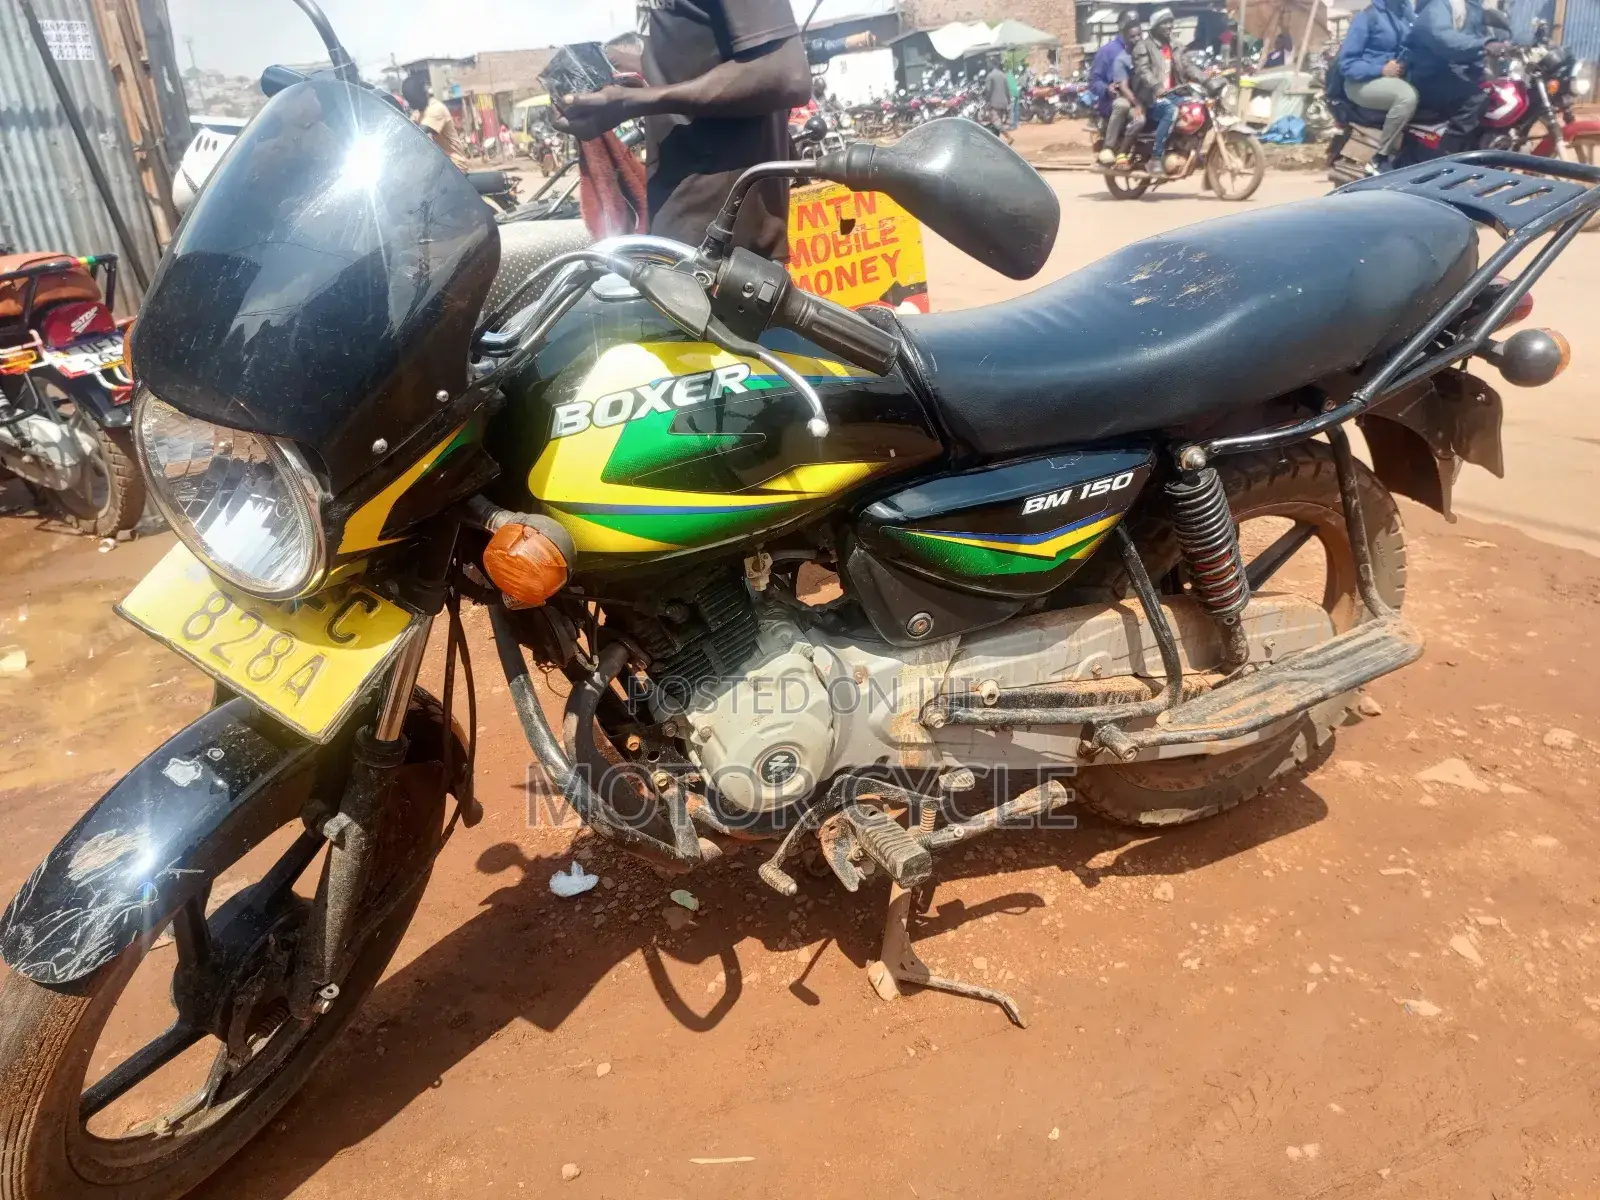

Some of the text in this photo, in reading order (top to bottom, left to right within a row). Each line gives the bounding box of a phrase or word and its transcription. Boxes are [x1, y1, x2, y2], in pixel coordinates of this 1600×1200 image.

[797, 191, 877, 231] MTN
[787, 217, 900, 269] MOBILE
[550, 363, 752, 441] BOXER
[1021, 472, 1135, 516] BM 150
[182, 589, 326, 707] 828A
